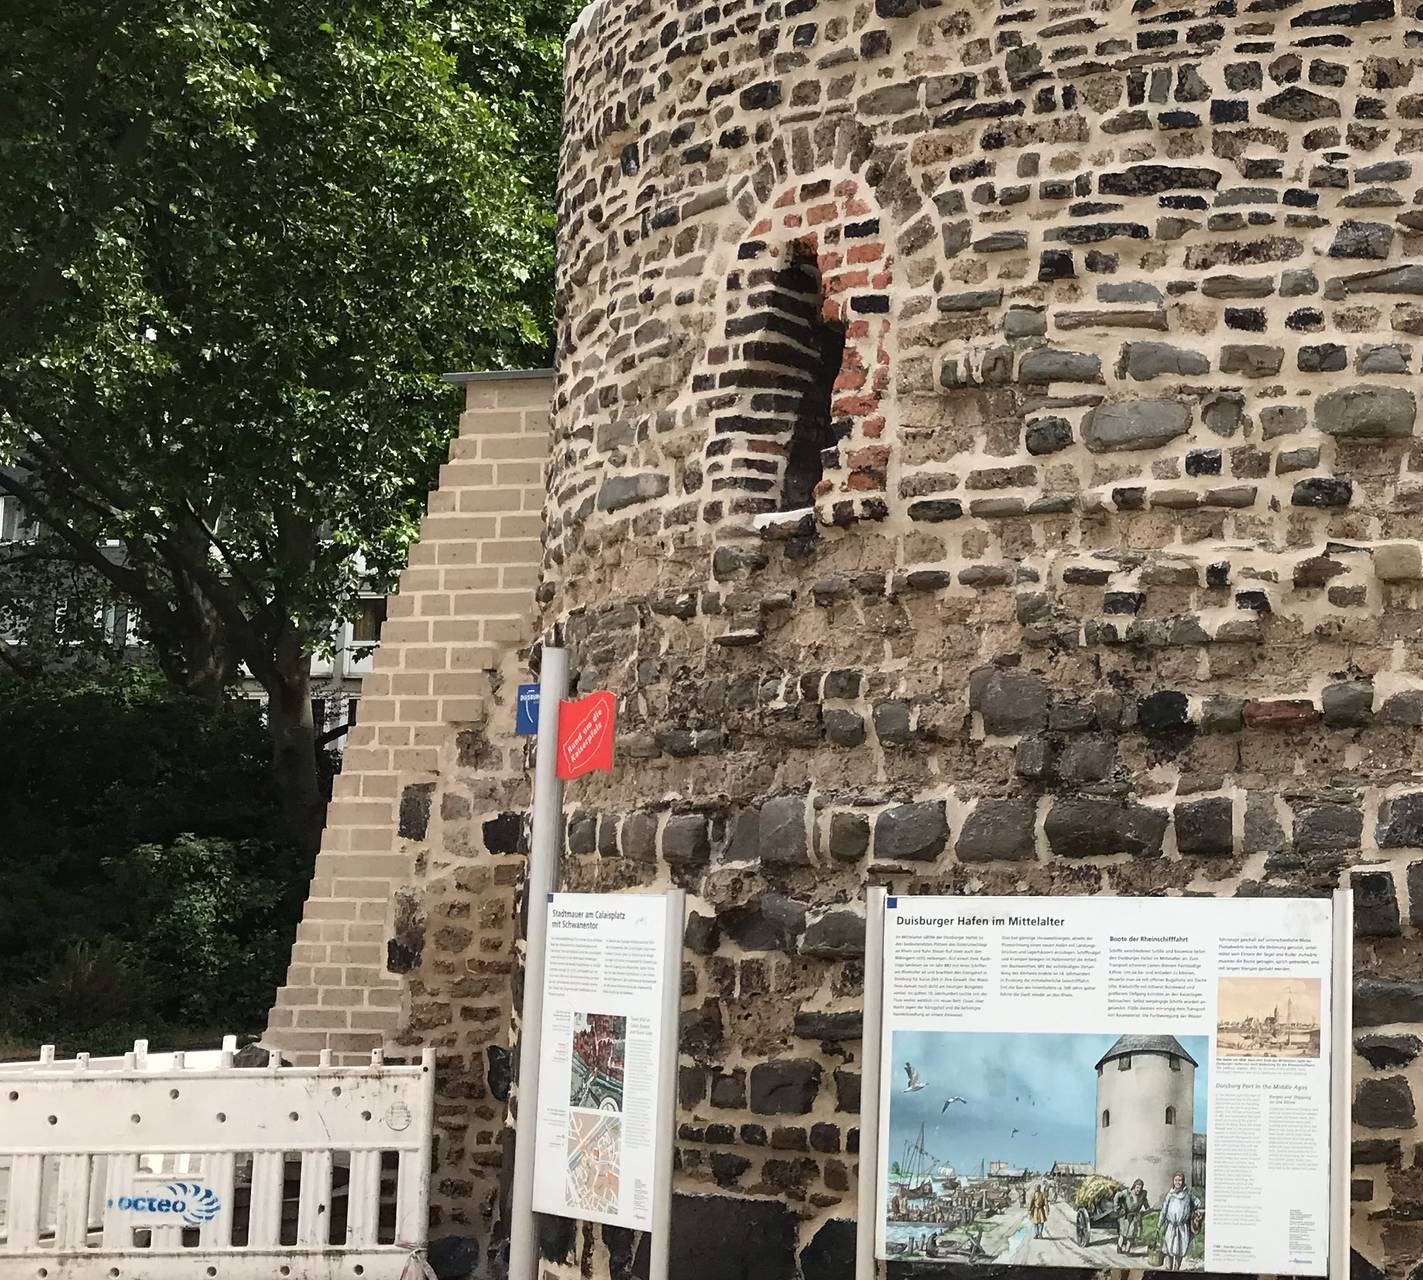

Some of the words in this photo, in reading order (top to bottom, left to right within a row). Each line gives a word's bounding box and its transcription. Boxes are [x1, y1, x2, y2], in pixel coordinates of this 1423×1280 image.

[567, 735, 583, 754] Rund
[582, 723, 592, 735] um
[592, 709, 603, 722] die
[570, 722, 603, 762] Kaiserpfalz
[552, 909, 584, 919] Stadtmauer
[585, 911, 594, 919] am
[595, 910, 626, 921] Calaisplatz
[896, 915, 955, 927] Duisburger
[957, 916, 989, 926] Hafen
[992, 916, 1005, 926] im
[1008, 916, 1065, 926] Mittelalter
[551, 920, 561, 928] mit
[562, 920, 599, 930] Schwanentor
[118, 1196, 186, 1213] octeo
